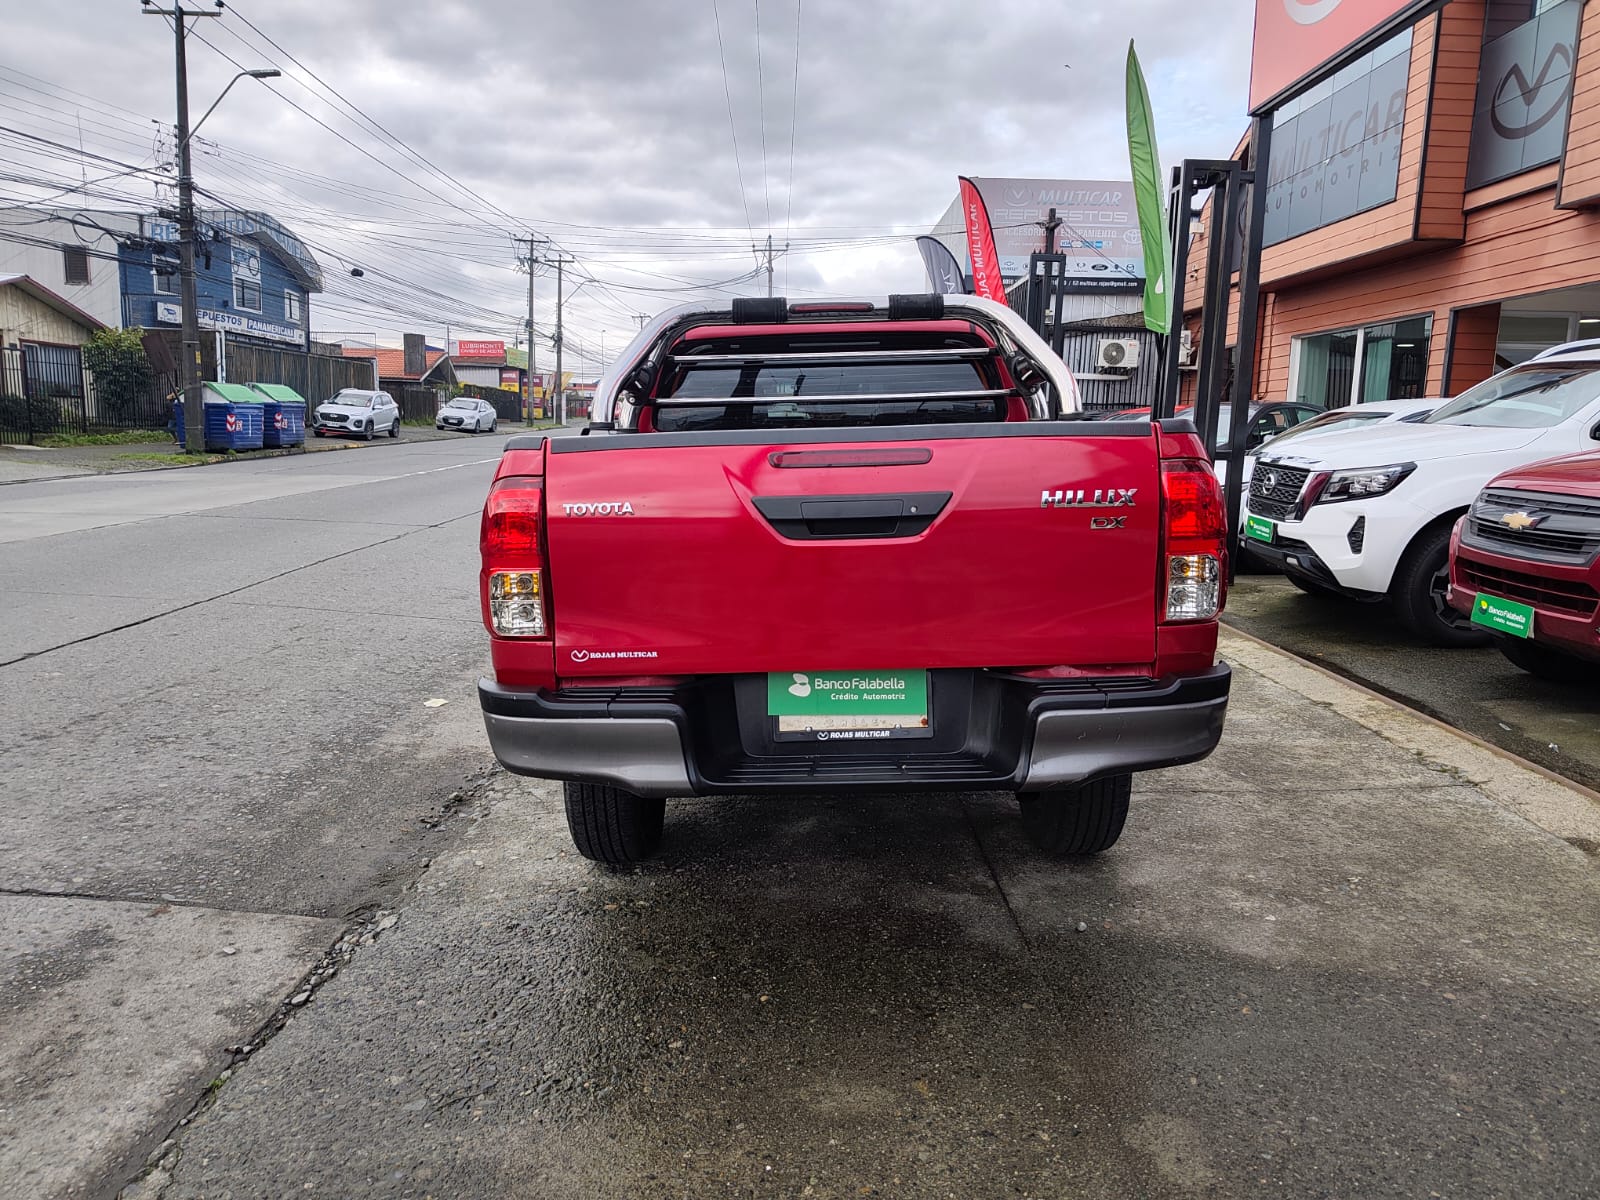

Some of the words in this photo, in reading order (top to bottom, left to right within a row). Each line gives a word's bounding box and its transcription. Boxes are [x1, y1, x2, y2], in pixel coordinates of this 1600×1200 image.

[1036, 190, 1122, 207] MULTICAR
[196, 310, 242, 326] EPUESTOS
[1041, 488, 1138, 508] HILUX
[563, 502, 635, 517] TOYOTA
[1090, 516, 1128, 530] DX
[831, 692, 859, 701] Crédito
[862, 692, 906, 701] Automotriz
[830, 731, 854, 739] ROJAS
[854, 730, 890, 738] MULTICAR
